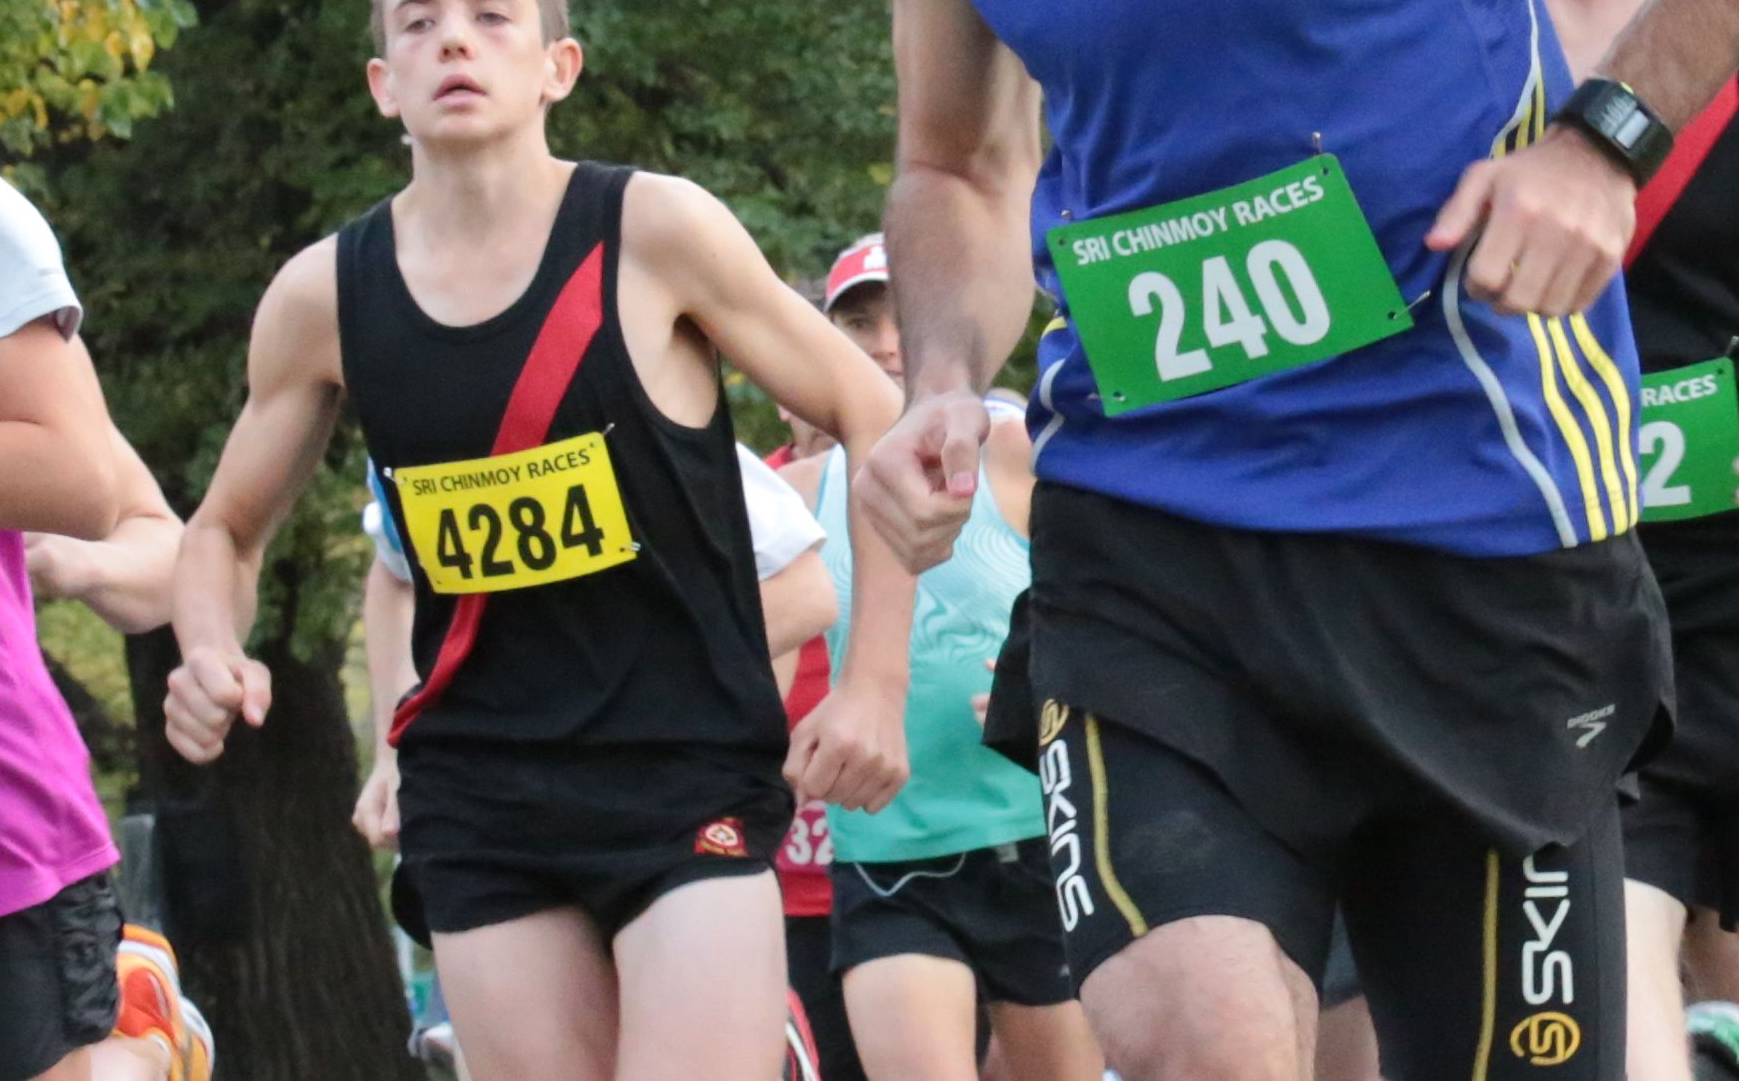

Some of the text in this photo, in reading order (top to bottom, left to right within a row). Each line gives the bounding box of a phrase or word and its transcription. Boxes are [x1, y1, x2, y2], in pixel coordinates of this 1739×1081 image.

[1073, 174, 1325, 266] SRI CHINMOY RACES
[1127, 239, 1331, 382] 240
[1640, 374, 1718, 407] RACES
[413, 448, 591, 496] SRI CHINMOY RACES
[437, 484, 605, 580] 4284
